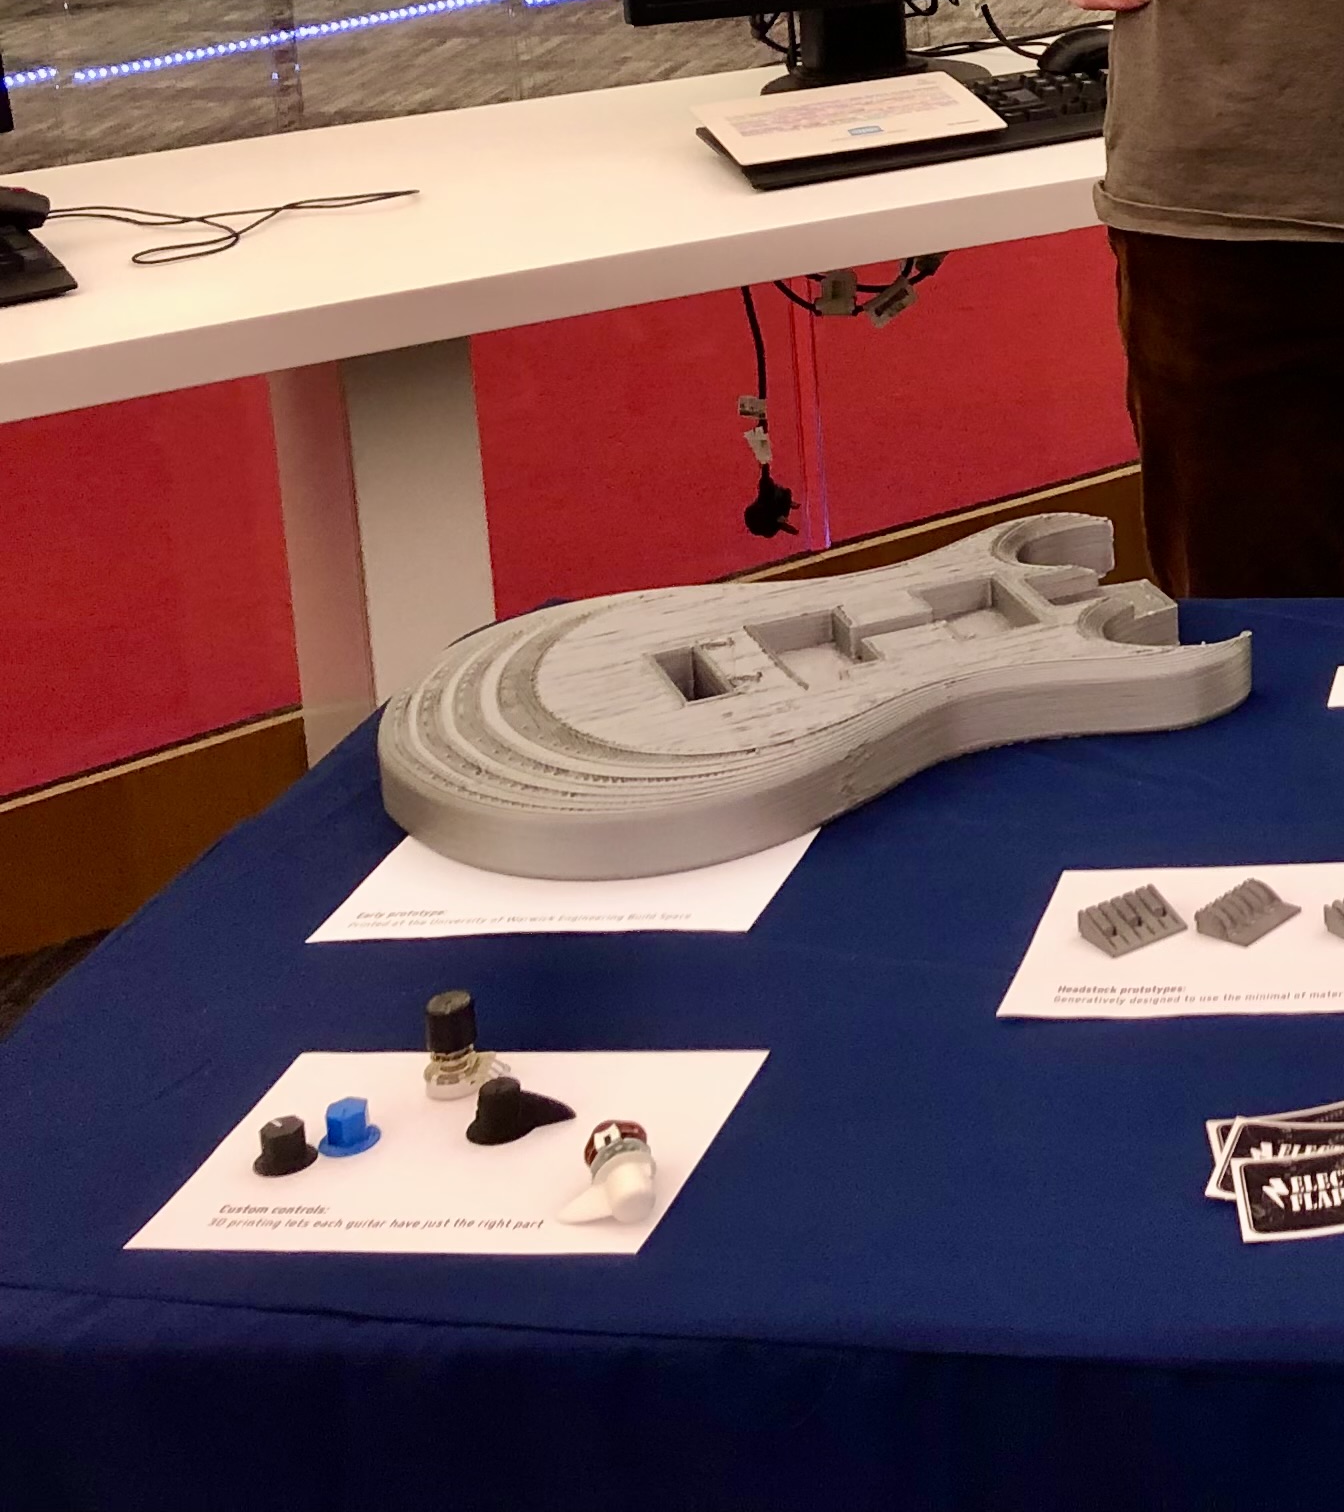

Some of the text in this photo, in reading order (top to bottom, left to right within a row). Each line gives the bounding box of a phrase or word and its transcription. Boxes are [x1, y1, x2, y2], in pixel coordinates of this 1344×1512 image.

[1057, 985, 1117, 994] Headstock
[1053, 995, 1126, 1006] Generatively
[1129, 995, 1181, 1006] designed
[1184, 995, 1196, 1004] to
[1199, 994, 1219, 1003] use
[1223, 993, 1242, 1002] the
[1244, 991, 1291, 1002] minimal
[1294, 990, 1307, 1000] of
[218, 1204, 331, 1215] Custom controls:
[208, 1217, 545, 1231] 3D printing lets each guitar have just the right part
